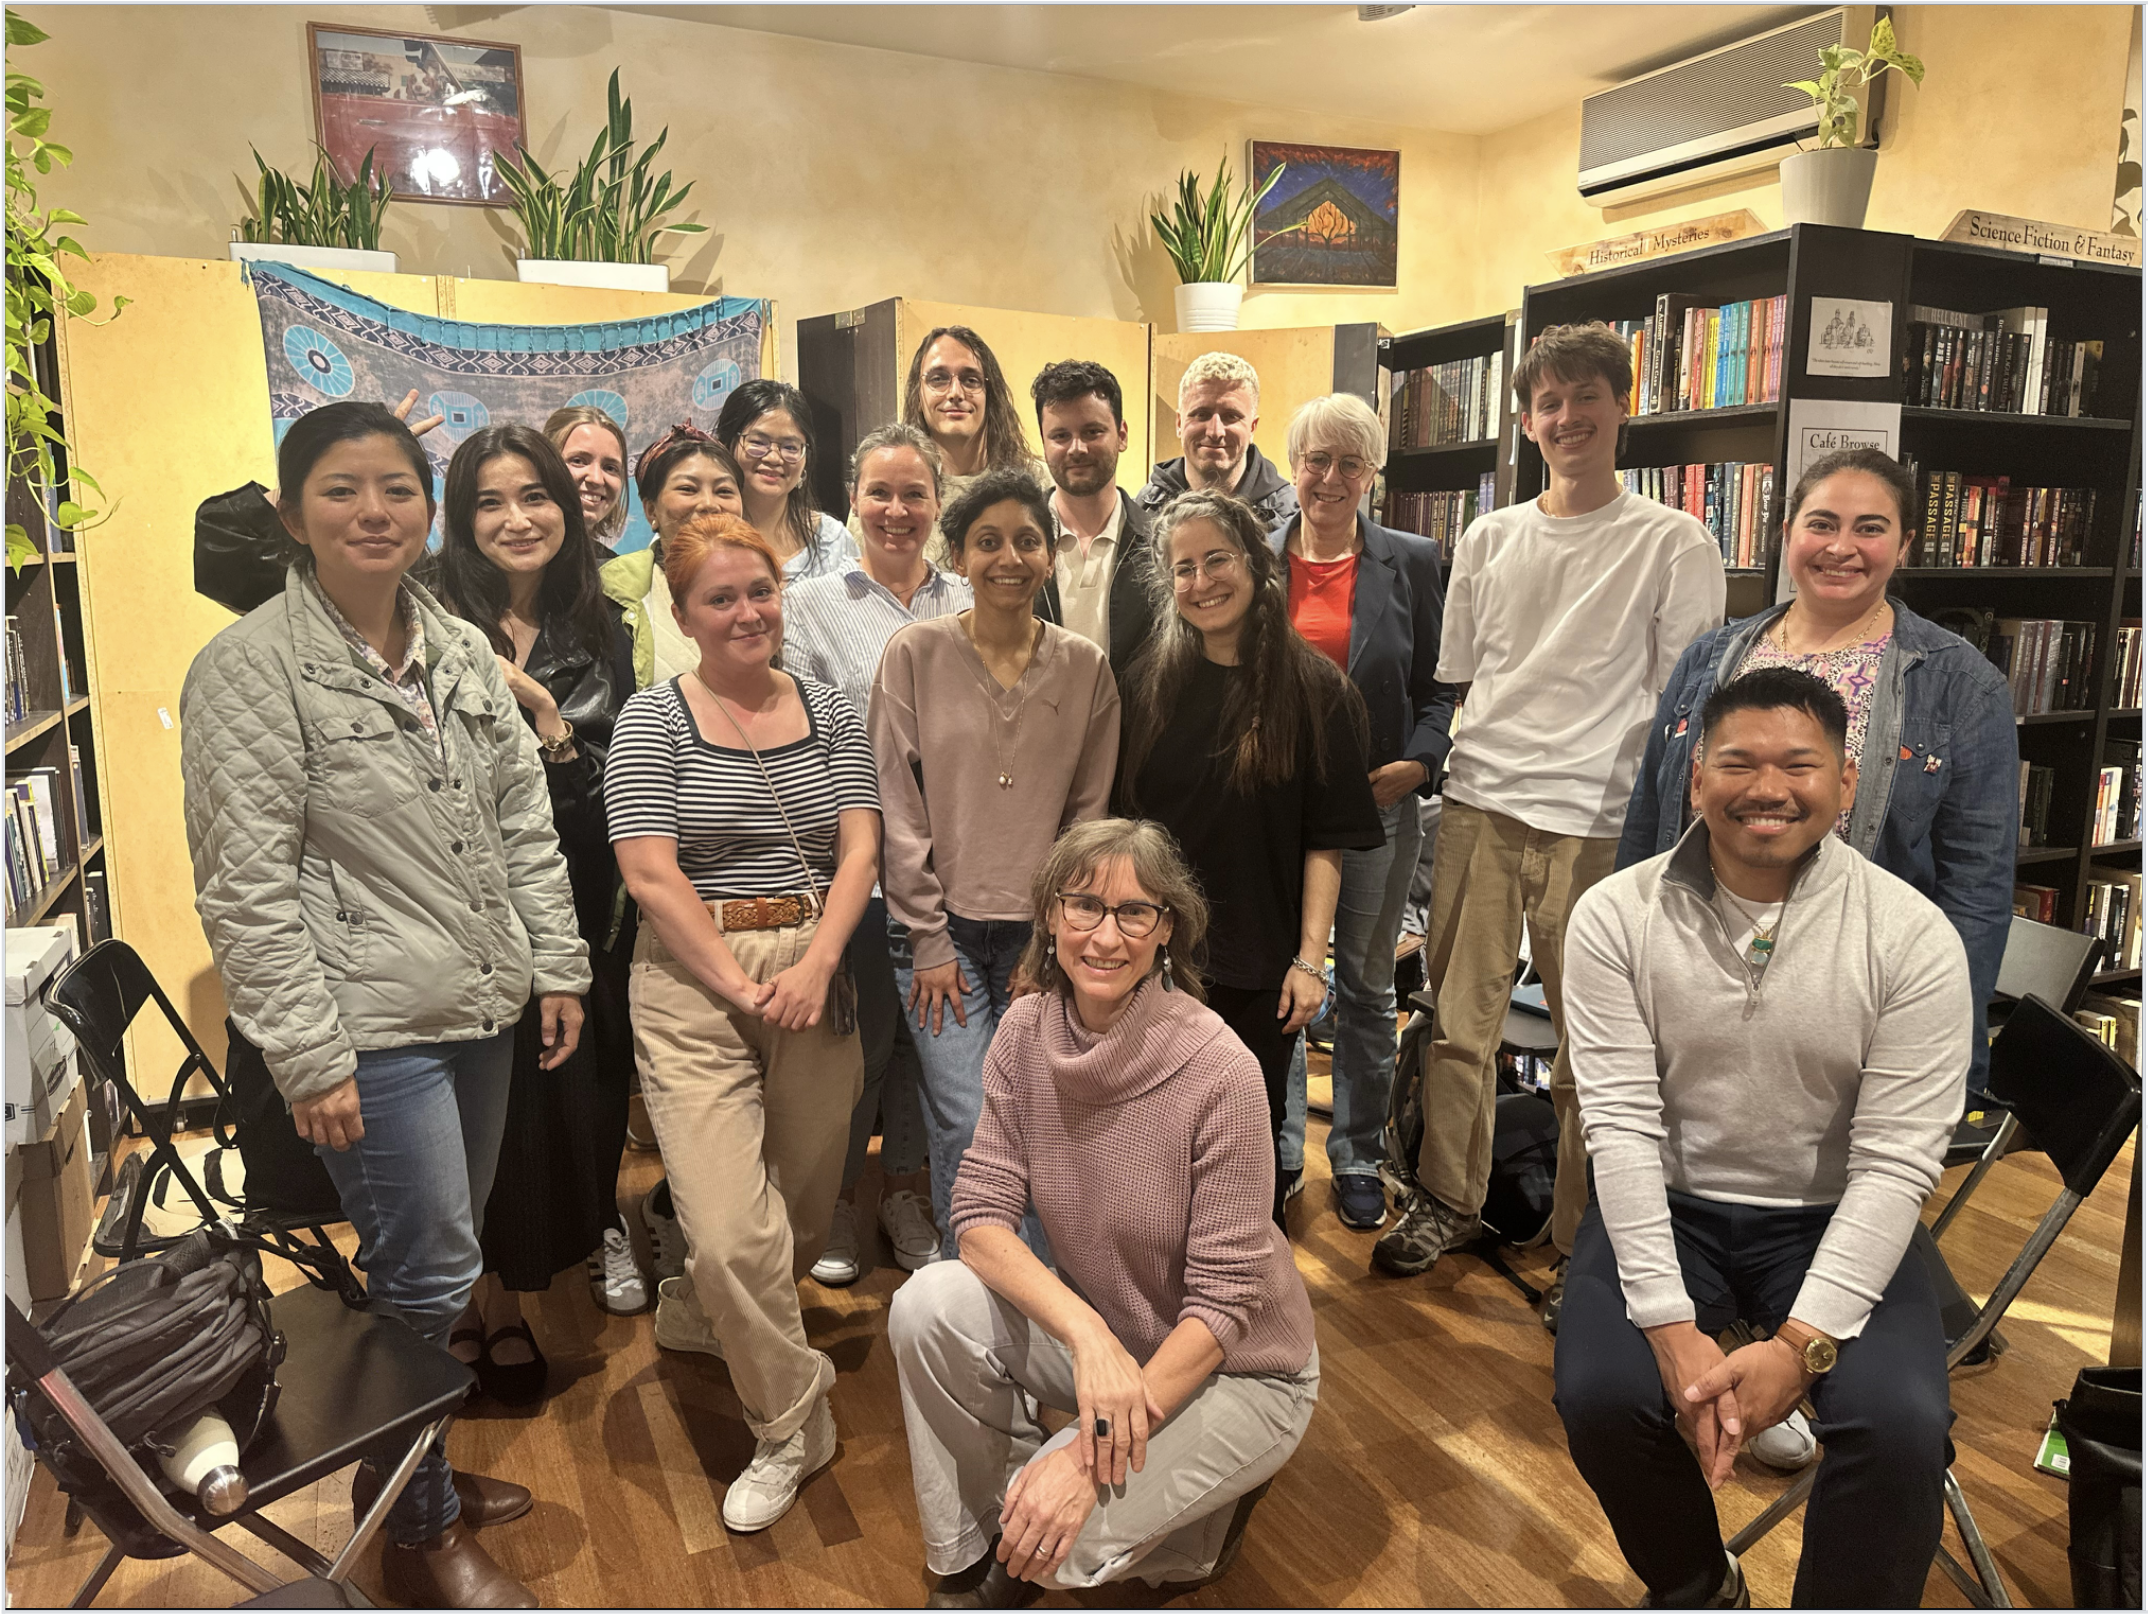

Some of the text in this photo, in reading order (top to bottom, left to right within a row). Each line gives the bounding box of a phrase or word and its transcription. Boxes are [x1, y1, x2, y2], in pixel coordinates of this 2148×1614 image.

[1589, 230, 1710, 265] Historical Mysteries
[1970, 215, 2136, 266] Science Fiction & Fantasy
[1810, 432, 1880, 450] Café Browse
[1761, 511, 1770, 523] Pit
[1762, 493, 1770, 511] Bear
[1925, 483, 1941, 540] PASSAGE
[1942, 484, 1955, 540] PASSAGE
